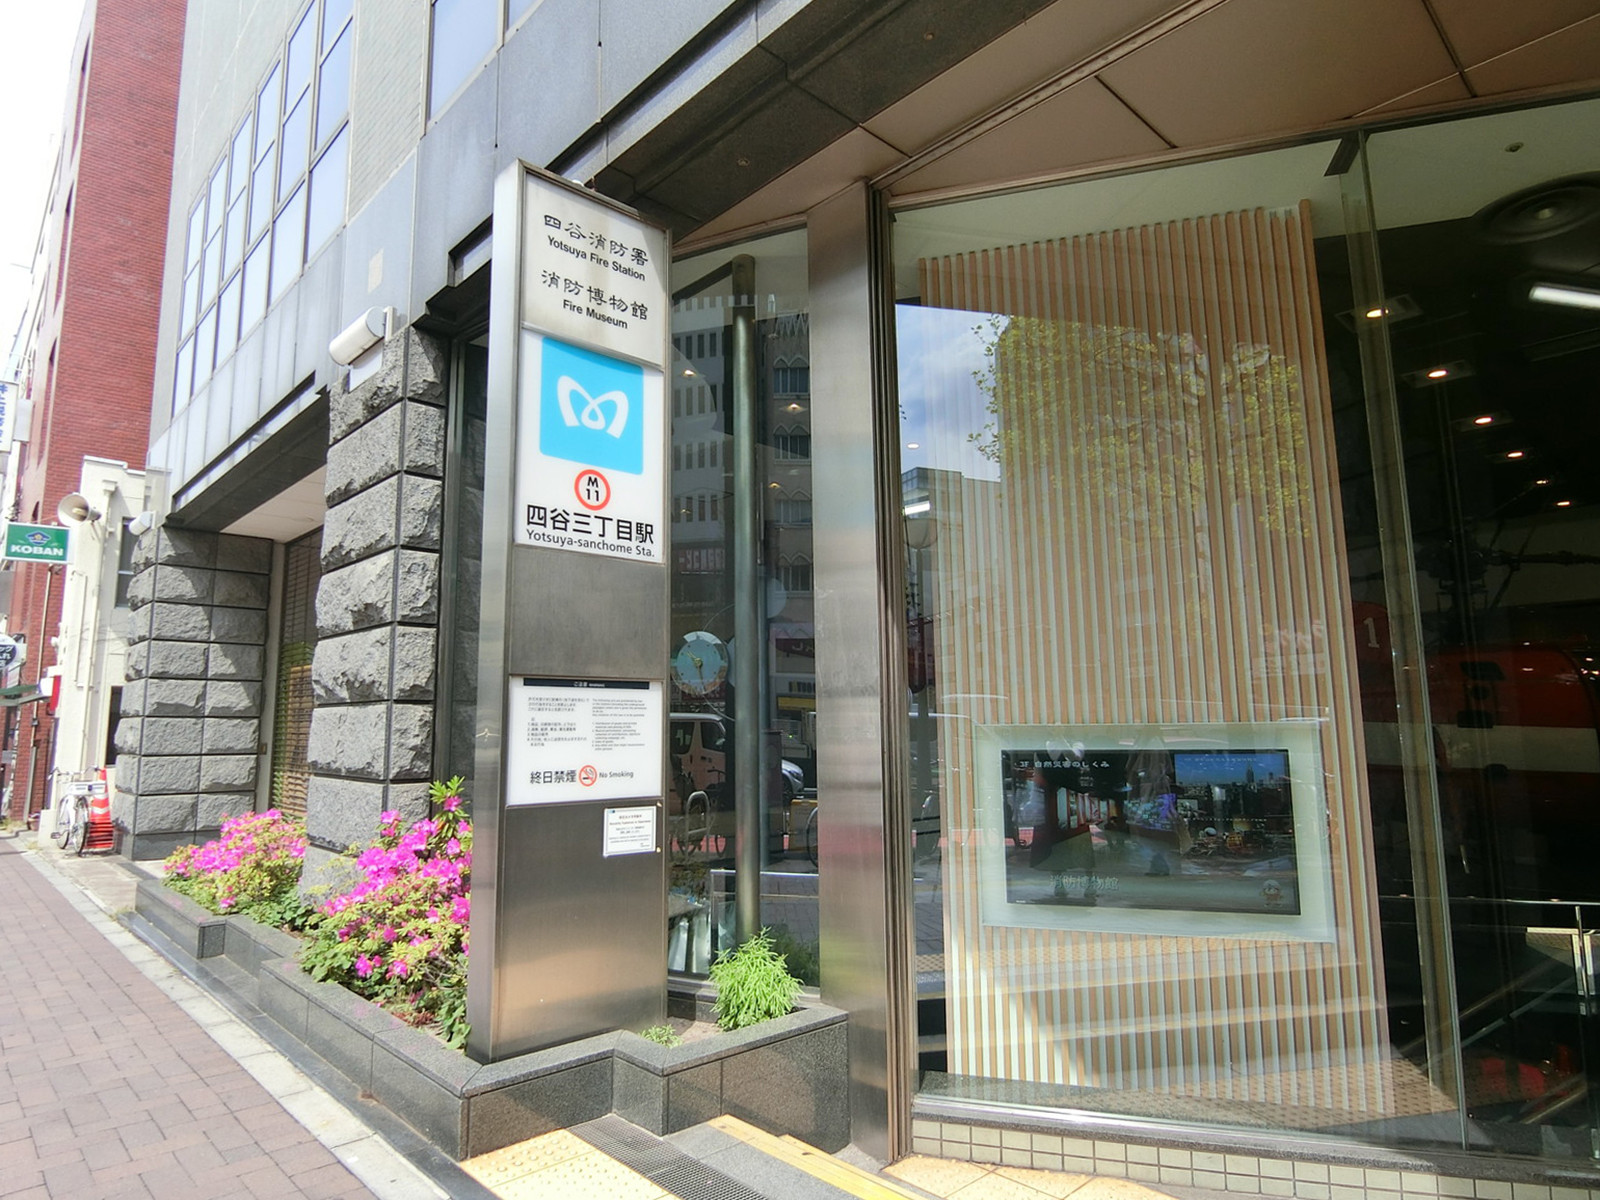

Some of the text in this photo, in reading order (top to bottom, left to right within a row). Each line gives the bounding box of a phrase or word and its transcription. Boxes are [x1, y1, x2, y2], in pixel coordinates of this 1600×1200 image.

[544, 214, 648, 266] 四谷消防署
[547, 235, 646, 281] Yotsuya Fire Station
[541, 269, 648, 320] 消防博物館
[562, 299, 628, 329] Fire Museum
[586, 488, 600, 502] 11
[587, 476, 599, 488] M
[526, 504, 654, 545] 四谷三丁目駅
[11, 544, 64, 556] KOBAN
[526, 528, 655, 558] Yotsuya-sanchome Sta.
[530, 769, 577, 785] 終日禁煙
[609, 770, 634, 779] Smoking
